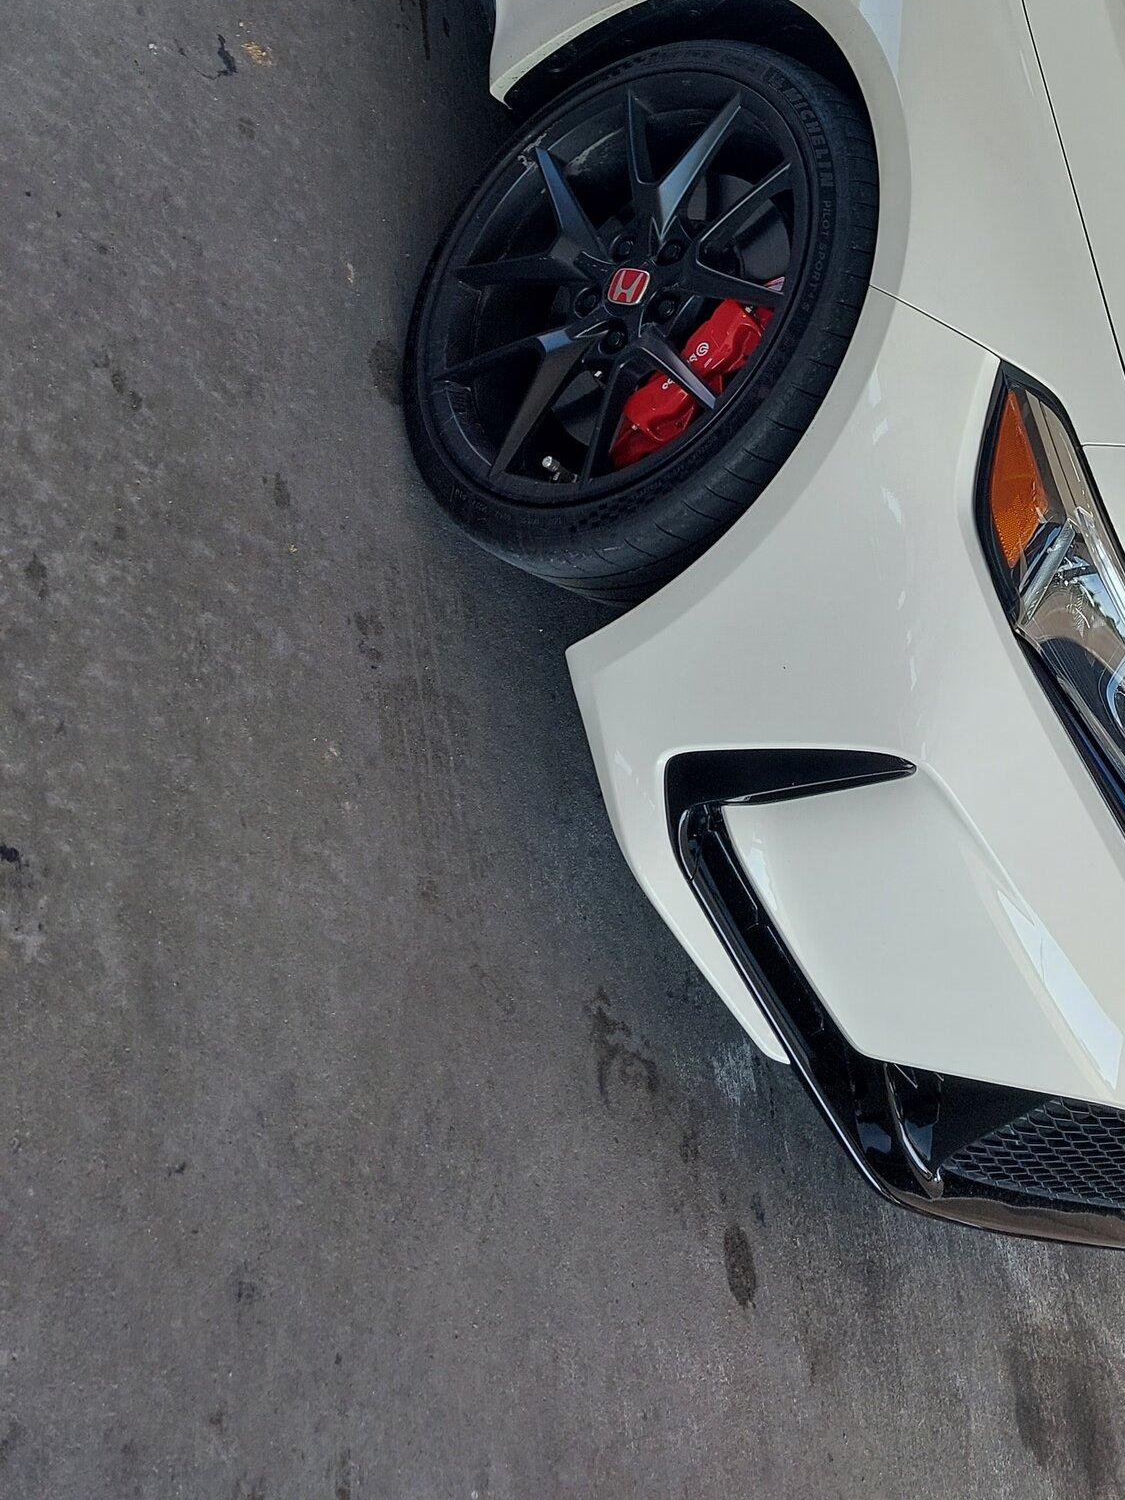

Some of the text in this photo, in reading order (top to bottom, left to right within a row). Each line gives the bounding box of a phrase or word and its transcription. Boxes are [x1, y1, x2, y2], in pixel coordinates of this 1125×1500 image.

[782, 88, 835, 187] MICHELIN
[821, 200, 831, 235] PILOT
[809, 243, 826, 287] SPORT
